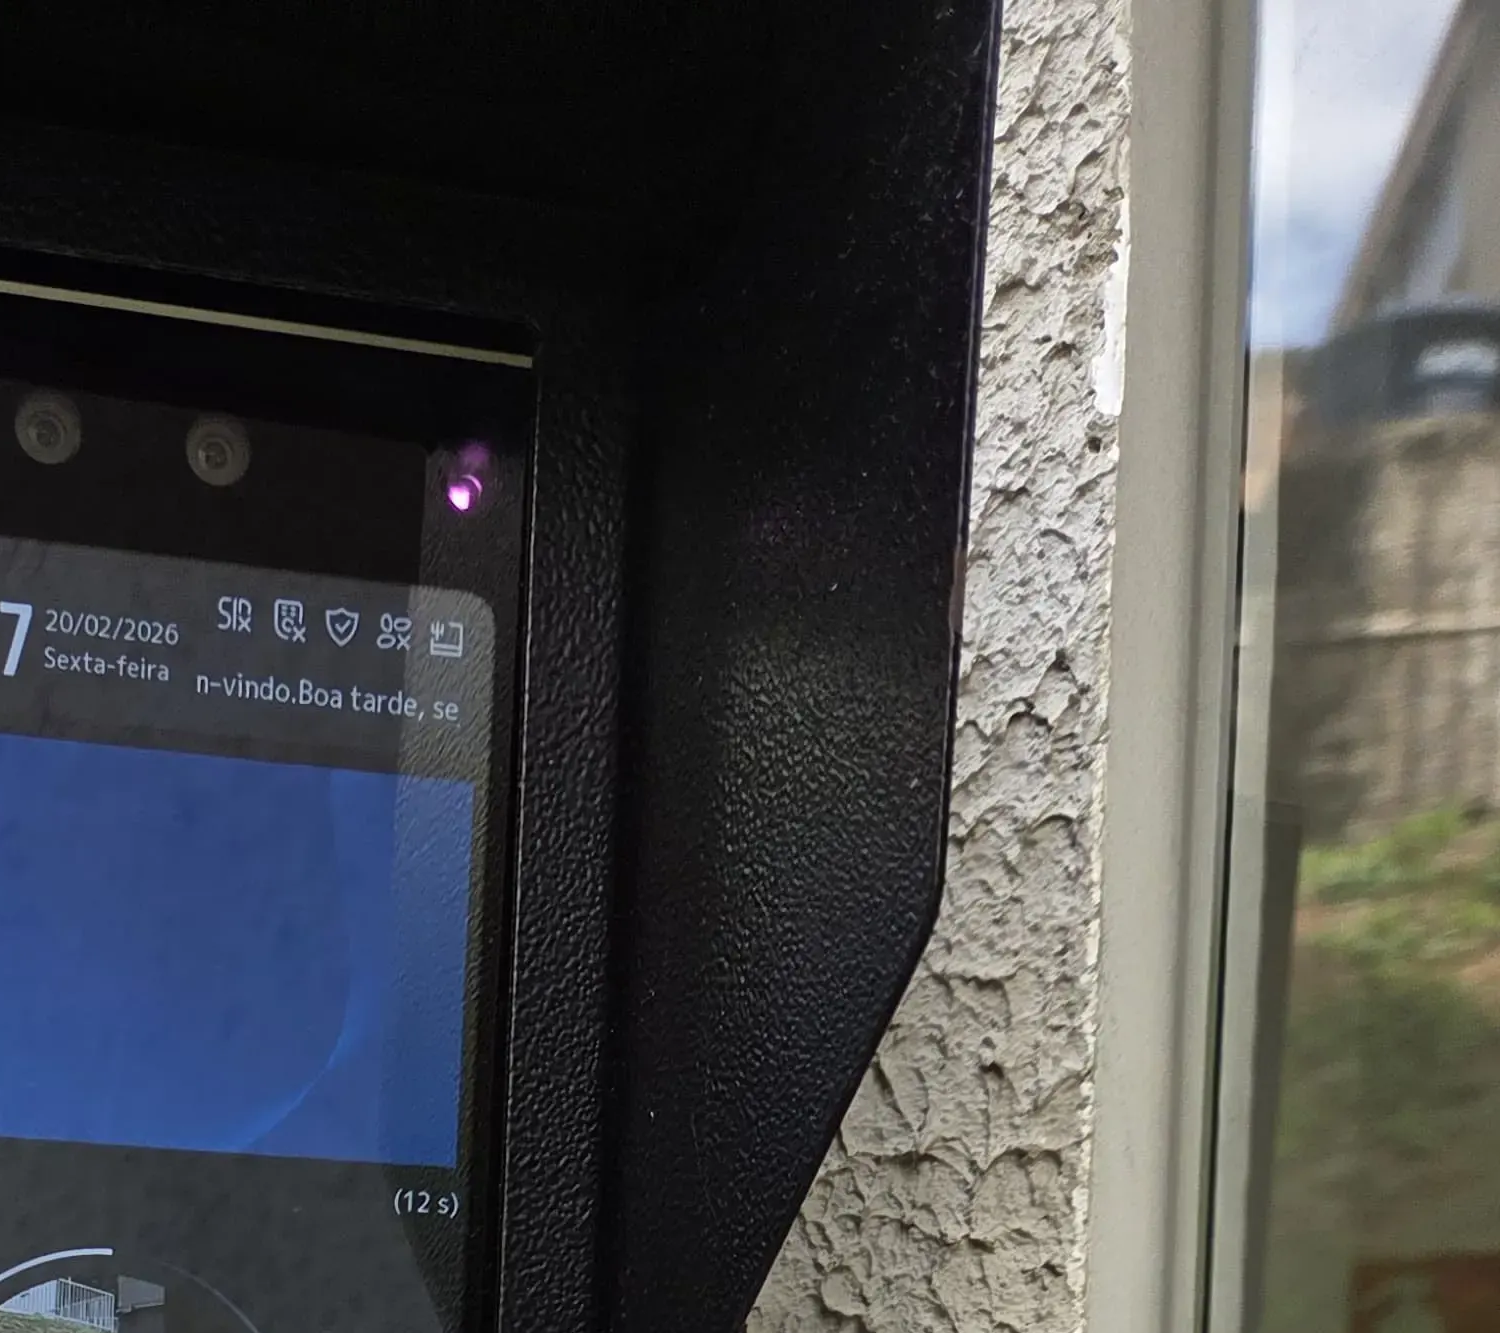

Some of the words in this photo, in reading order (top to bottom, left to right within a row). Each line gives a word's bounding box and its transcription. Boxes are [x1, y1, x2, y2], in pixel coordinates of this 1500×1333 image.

[45, 609, 179, 645] 20/02/2026
[43, 647, 171, 682] Sexta-feira
[350, 686, 425, 721] tarde,
